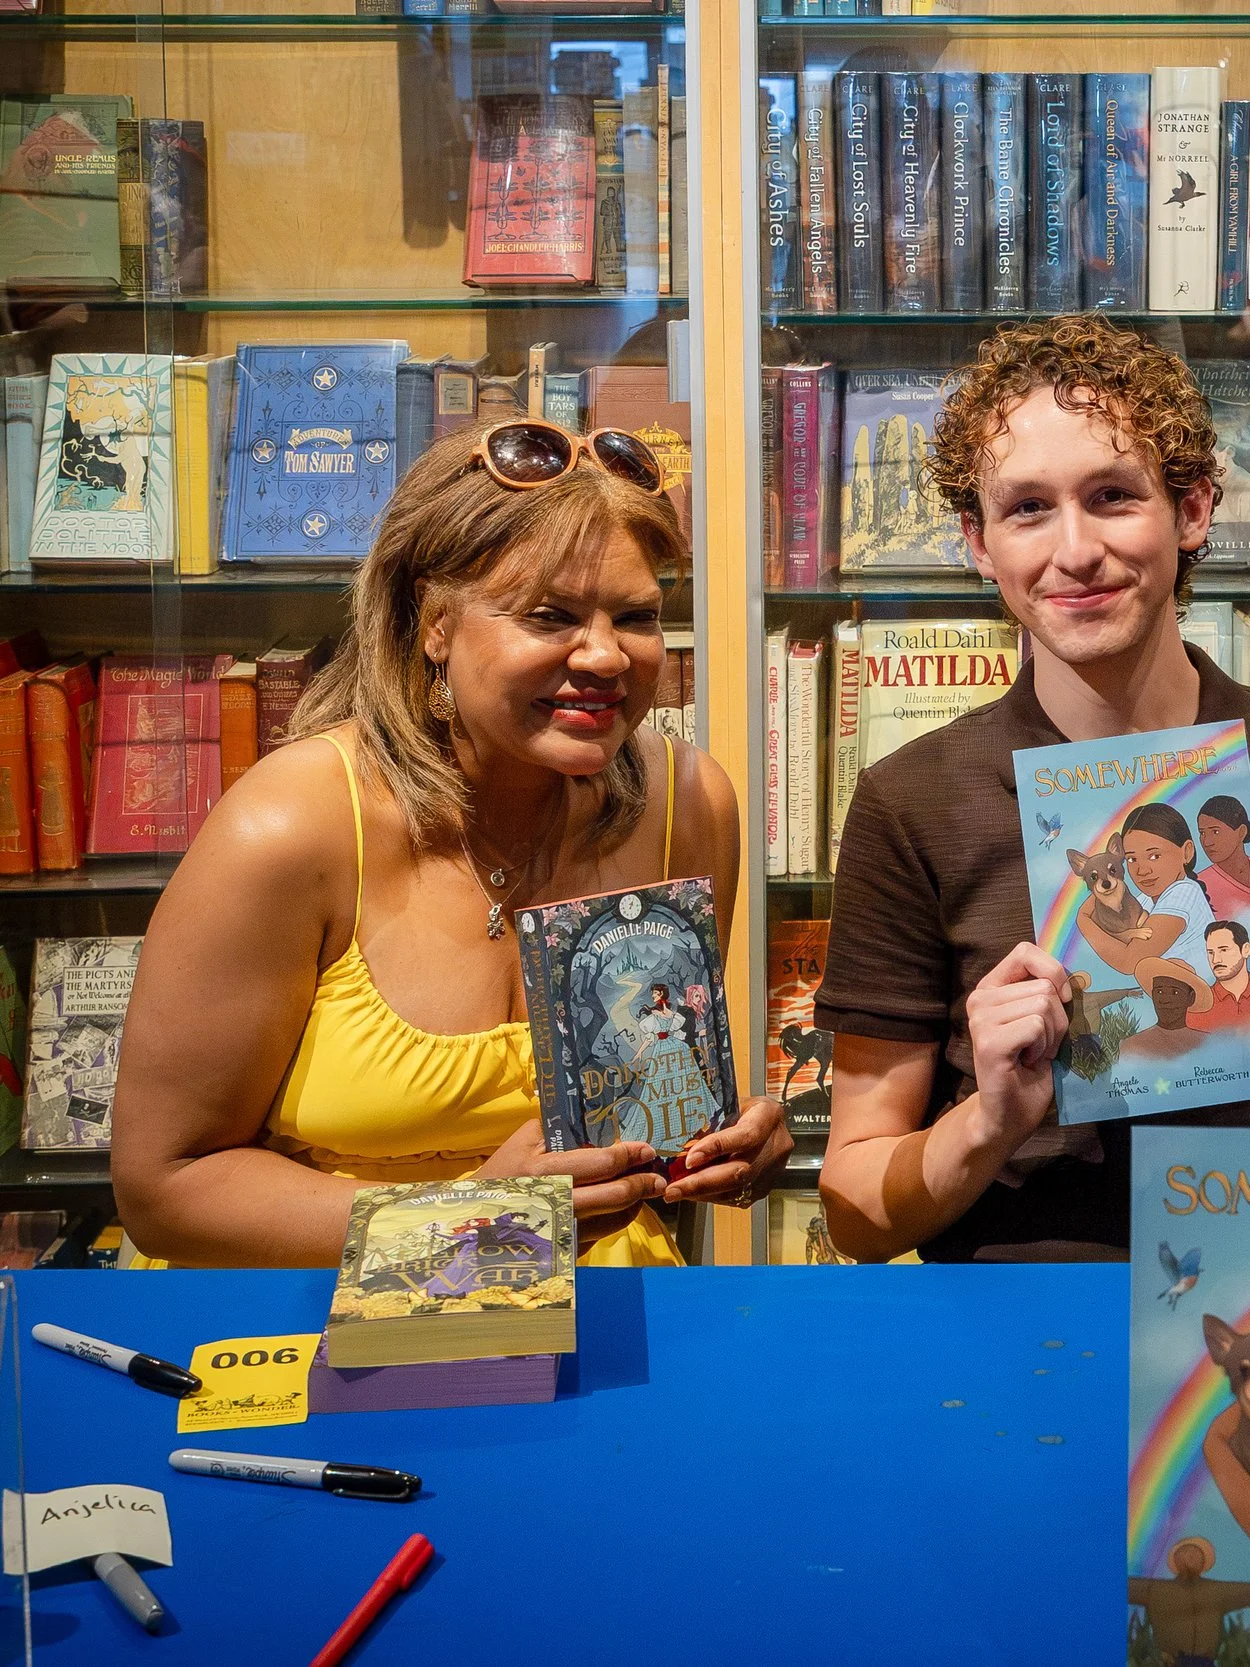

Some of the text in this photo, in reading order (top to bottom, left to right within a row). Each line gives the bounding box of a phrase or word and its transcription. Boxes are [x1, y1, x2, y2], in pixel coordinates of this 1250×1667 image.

[1040, 84, 1070, 92] CLARE
[1158, 113, 1210, 122] JONATHAN
[1158, 124, 1209, 133] STRANGE
[762, 108, 789, 247] City Ashes
[848, 103, 870, 248] City Lost Souls
[954, 102, 969, 246] Clockwork Prince
[1047, 101, 1065, 266] Lord Shadows
[1105, 100, 1119, 266] Queen Darkness
[805, 108, 827, 274] City Fallen Angels
[900, 106, 920, 273] City Heavenly Fire
[999, 108, 1014, 274] The Bane Chronicles
[548, 402, 575, 411] TARS
[552, 393, 571, 401] BOY
[912, 392, 934, 402] Cooper
[284, 450, 356, 475] TOM SAWYER.
[666, 456, 690, 469] EARTH
[47, 516, 148, 529] DOCTOR
[37, 529, 151, 542] DOLITTLE
[34, 542, 159, 555] IN THE MOON
[883, 629, 992, 649] Roald Dahl
[111, 667, 182, 688] The Magic
[864, 653, 1013, 687] MATILDA
[259, 680, 300, 690] BASTABLE
[840, 649, 860, 739] MATILDA
[904, 692, 971, 706] Illustrated by
[893, 706, 945, 720] Quentin
[768, 666, 780, 846] CHARLIE GREAT ELEVATOR
[799, 664, 812, 874] The Wonderful Story Henry Sugar
[837, 745, 848, 809] Quentin Blake
[1035, 745, 1219, 797] SOMEWHERE
[593, 921, 674, 953] DANIELLE PAIGE
[66, 970, 115, 980] THE PICTS
[66, 981, 132, 990] THE MARTYRS
[65, 1003, 97, 1011] ARTHUR
[582, 1047, 706, 1100] DOROTHY
[1175, 1070, 1250, 1089] BUTTERWORTH
[646, 1070, 716, 1102] MUST
[1105, 1085, 1149, 1098] THOMAS
[585, 1096, 708, 1148] DIE
[793, 1114, 832, 1123] WALTER
[410, 1191, 513, 1205] DANIELLE PAIGE
[371, 1258, 478, 1274] BRICK
[392, 1261, 540, 1292] WAR
[211, 1348, 299, 1369] 006
[241, 1405, 297, 1413] WONDER
[40, 1494, 156, 1526] Anjelica
